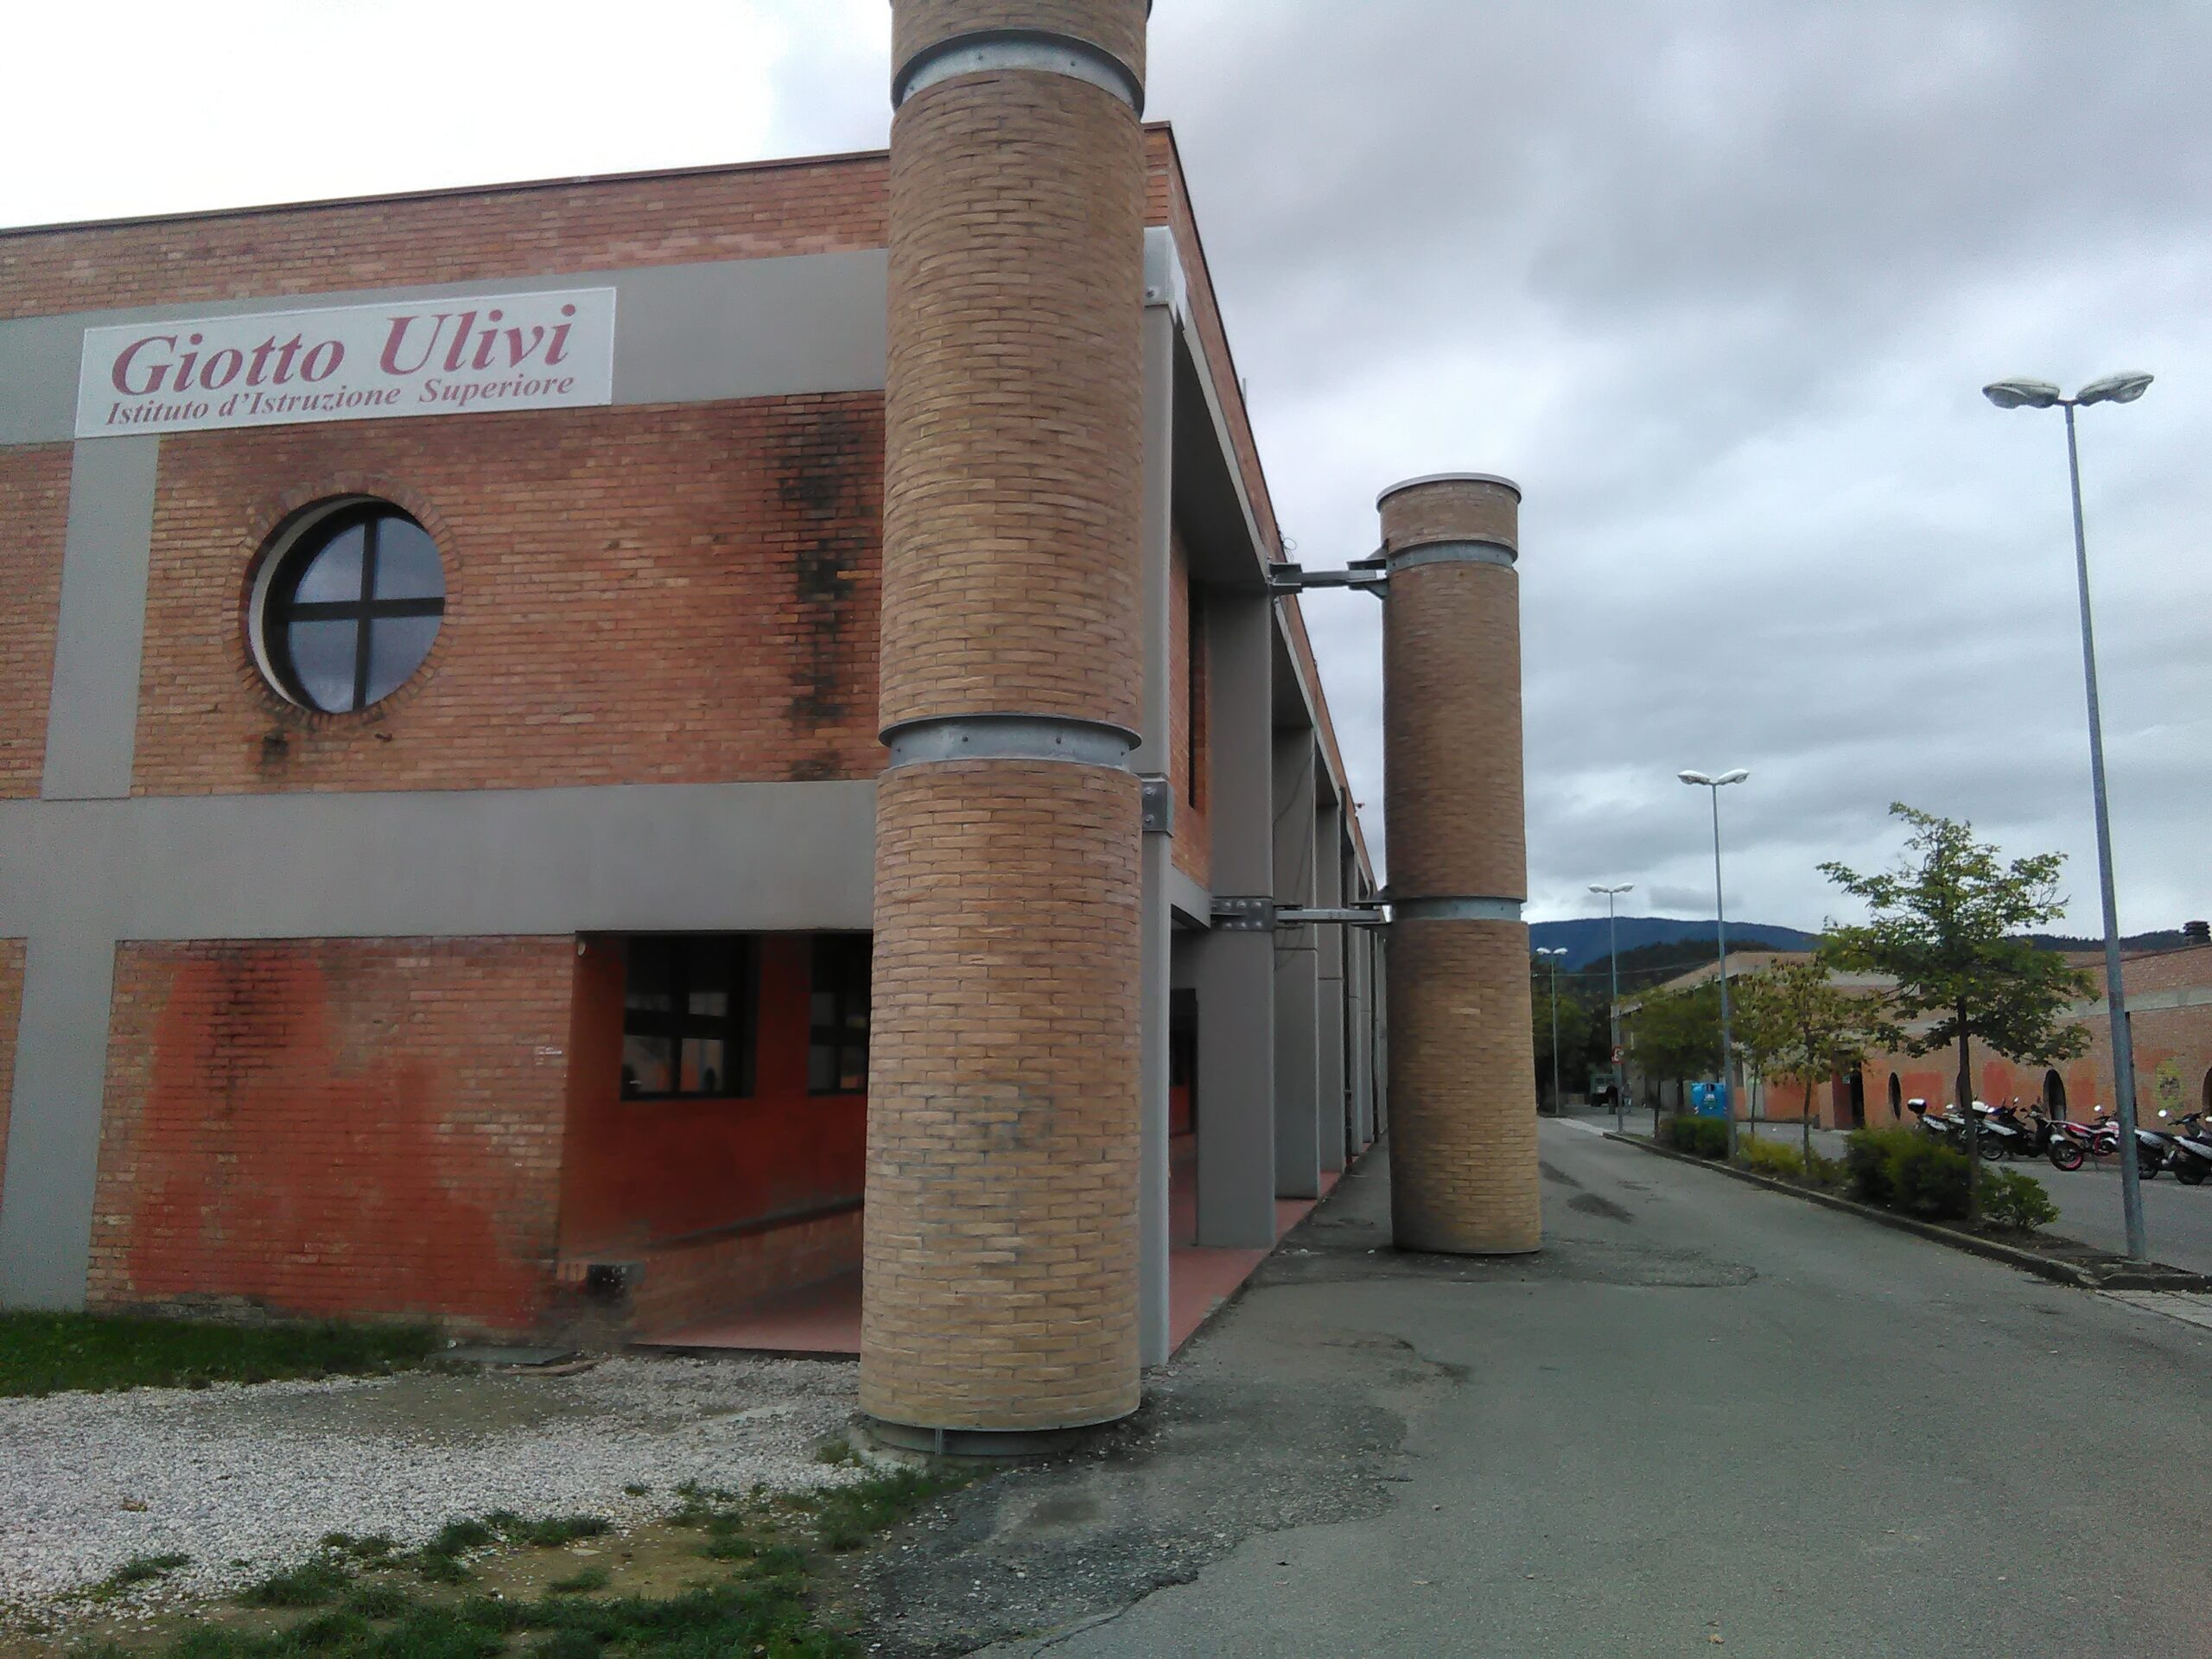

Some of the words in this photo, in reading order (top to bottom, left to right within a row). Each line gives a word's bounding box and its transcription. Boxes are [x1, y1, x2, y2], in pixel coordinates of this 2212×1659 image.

[111, 332, 345, 397] Giotto
[378, 302, 577, 376] Ulivi
[105, 397, 210, 426] Istituto
[218, 385, 401, 417] d'Istruzione
[419, 375, 575, 407] Superiore
